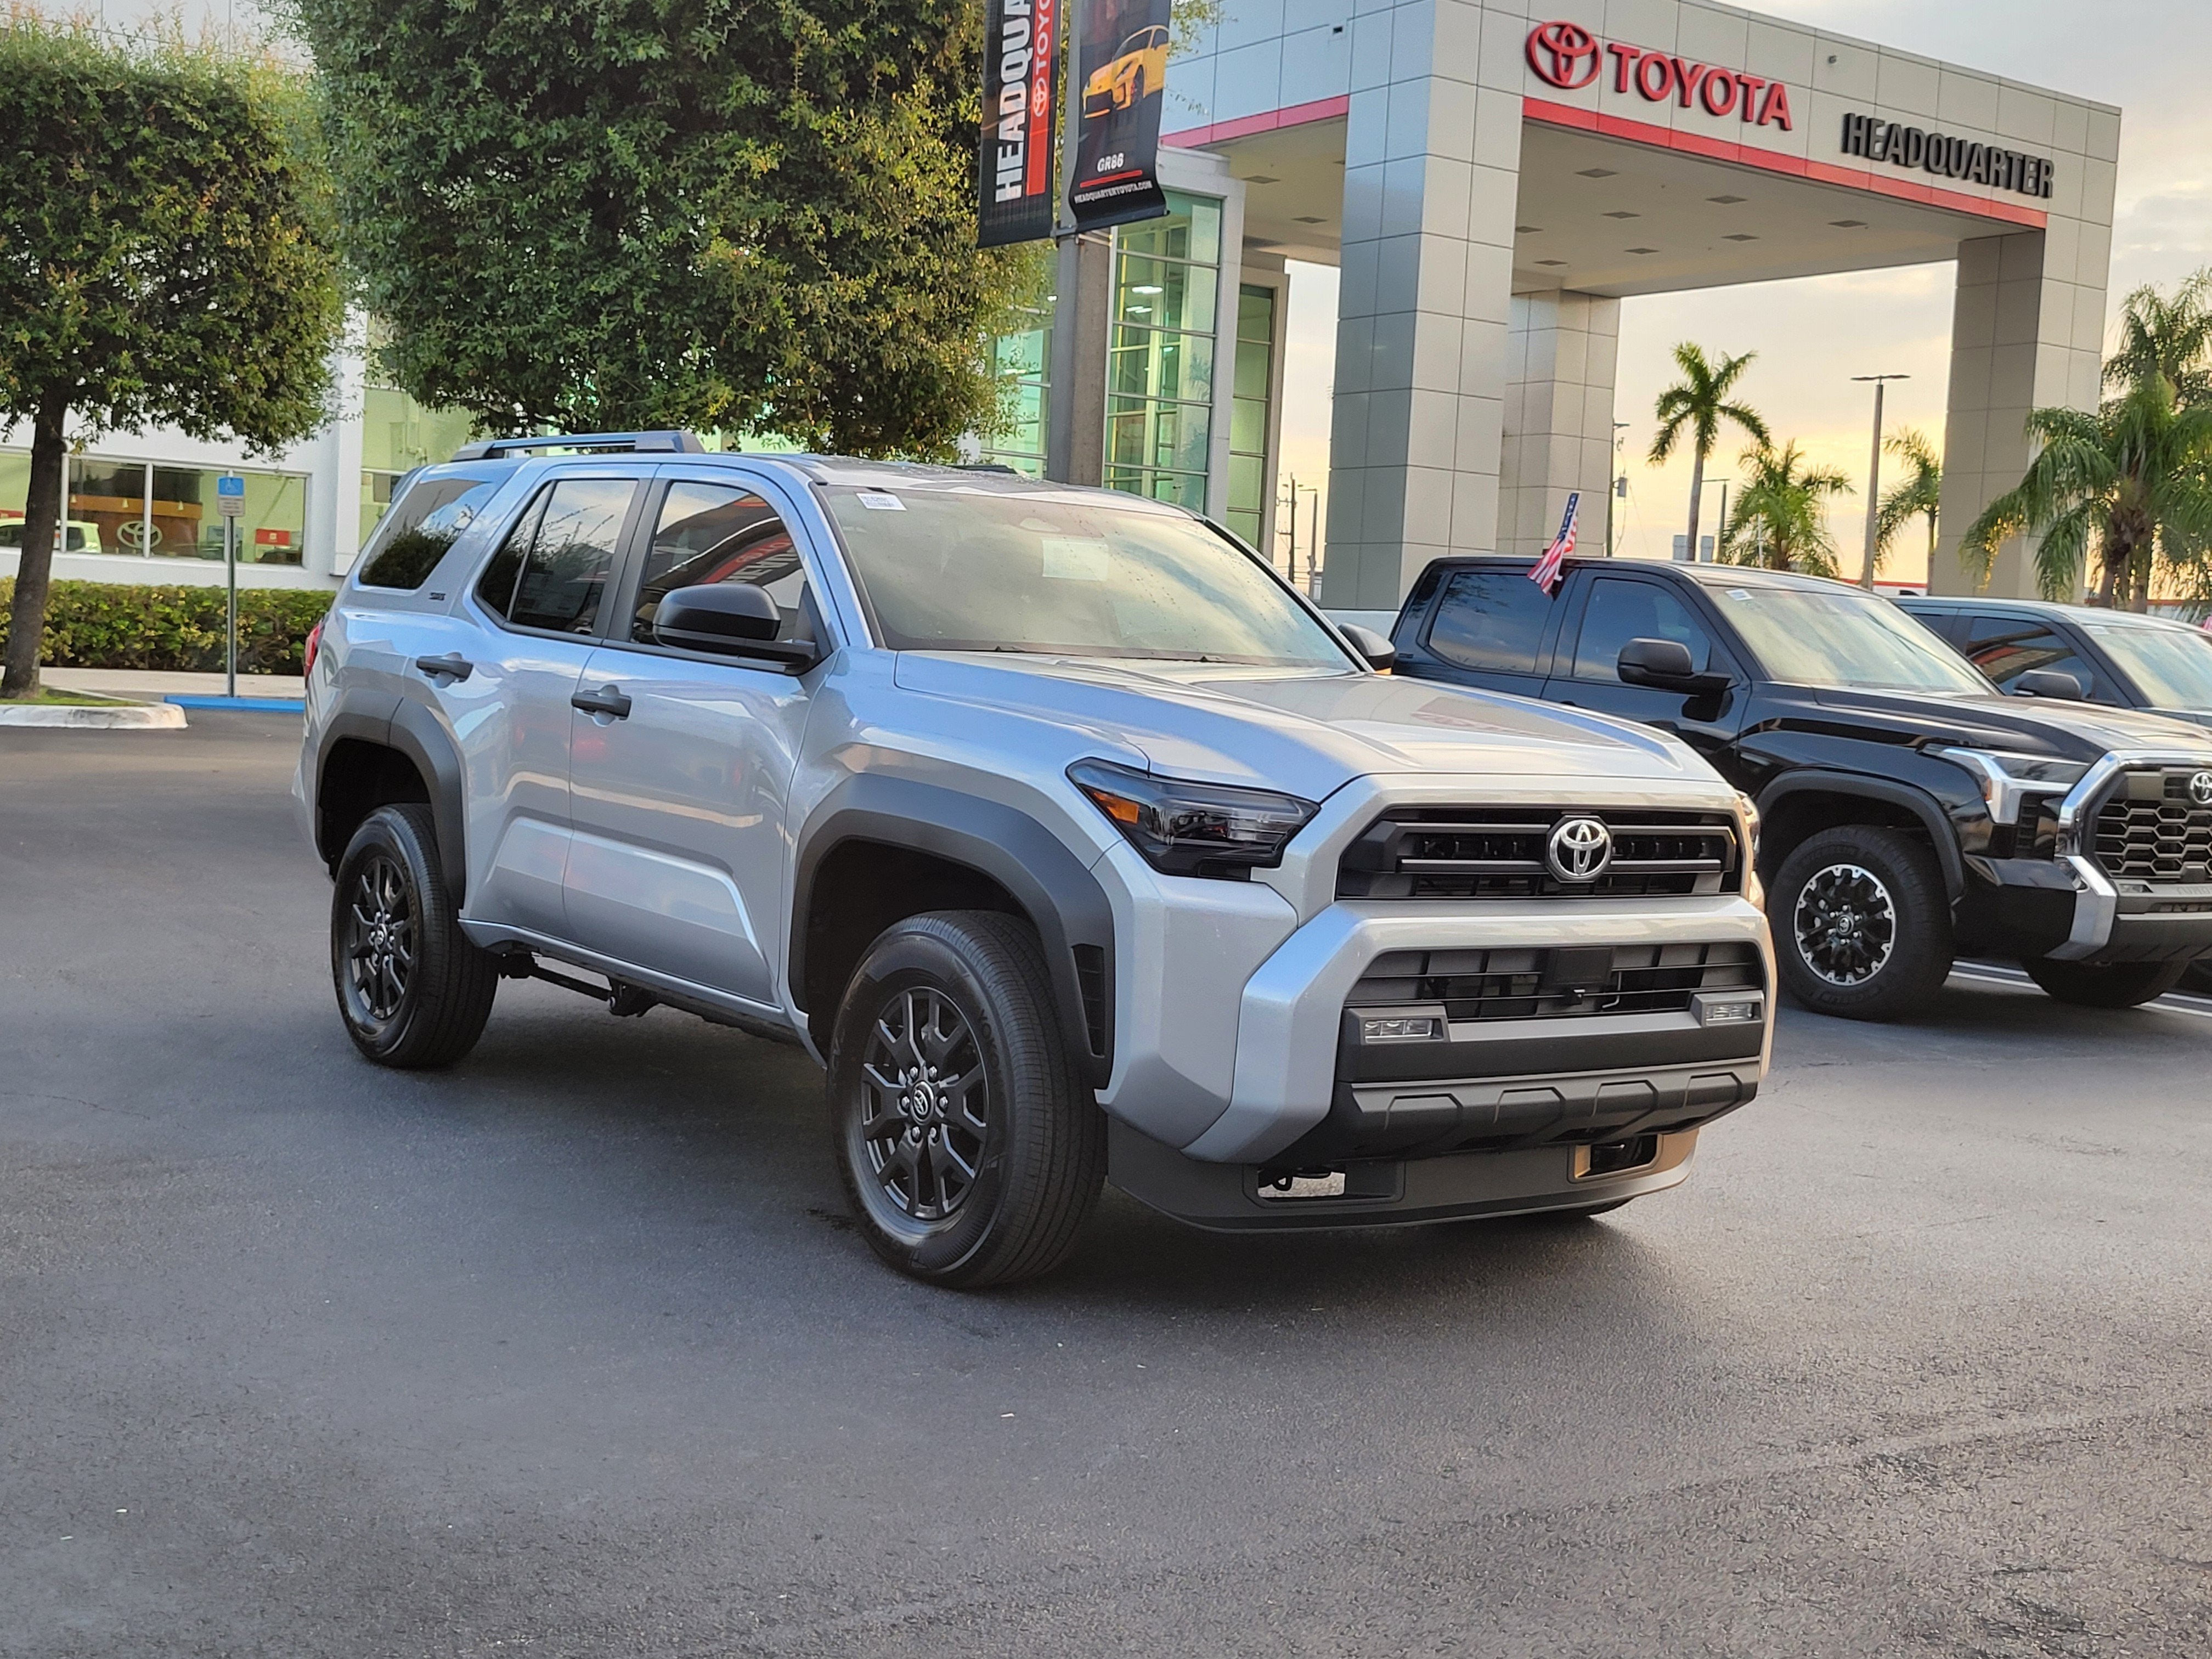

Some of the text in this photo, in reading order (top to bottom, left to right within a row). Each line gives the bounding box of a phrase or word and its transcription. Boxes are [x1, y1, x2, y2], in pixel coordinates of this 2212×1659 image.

[1608, 43, 1792, 131] TOYOTA
[1097, 153, 1124, 172] GR86
[1841, 112, 2055, 198] HEADQUARTER
